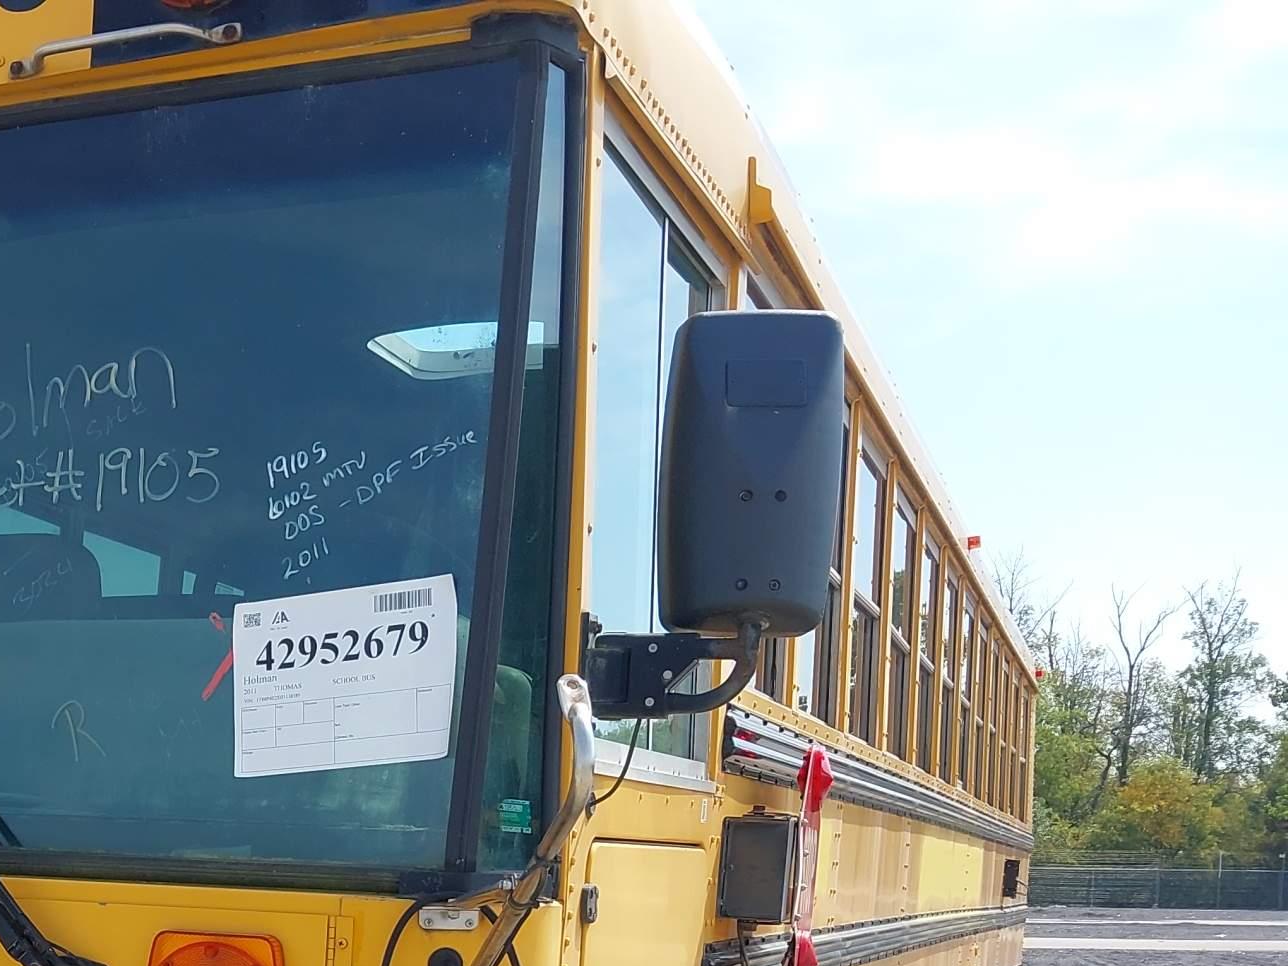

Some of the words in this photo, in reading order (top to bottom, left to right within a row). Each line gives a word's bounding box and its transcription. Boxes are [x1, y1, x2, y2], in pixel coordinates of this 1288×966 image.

[267, 441, 327, 488] 19105
[281, 537, 329, 580] 2011
[255, 620, 430, 671] 42952679
[243, 674, 278, 686] Holman
[273, 683, 302, 692] THOMAS
[332, 676, 361, 686] SCHOOL
[361, 673, 376, 682] BUS
[51, 700, 107, 762] R
